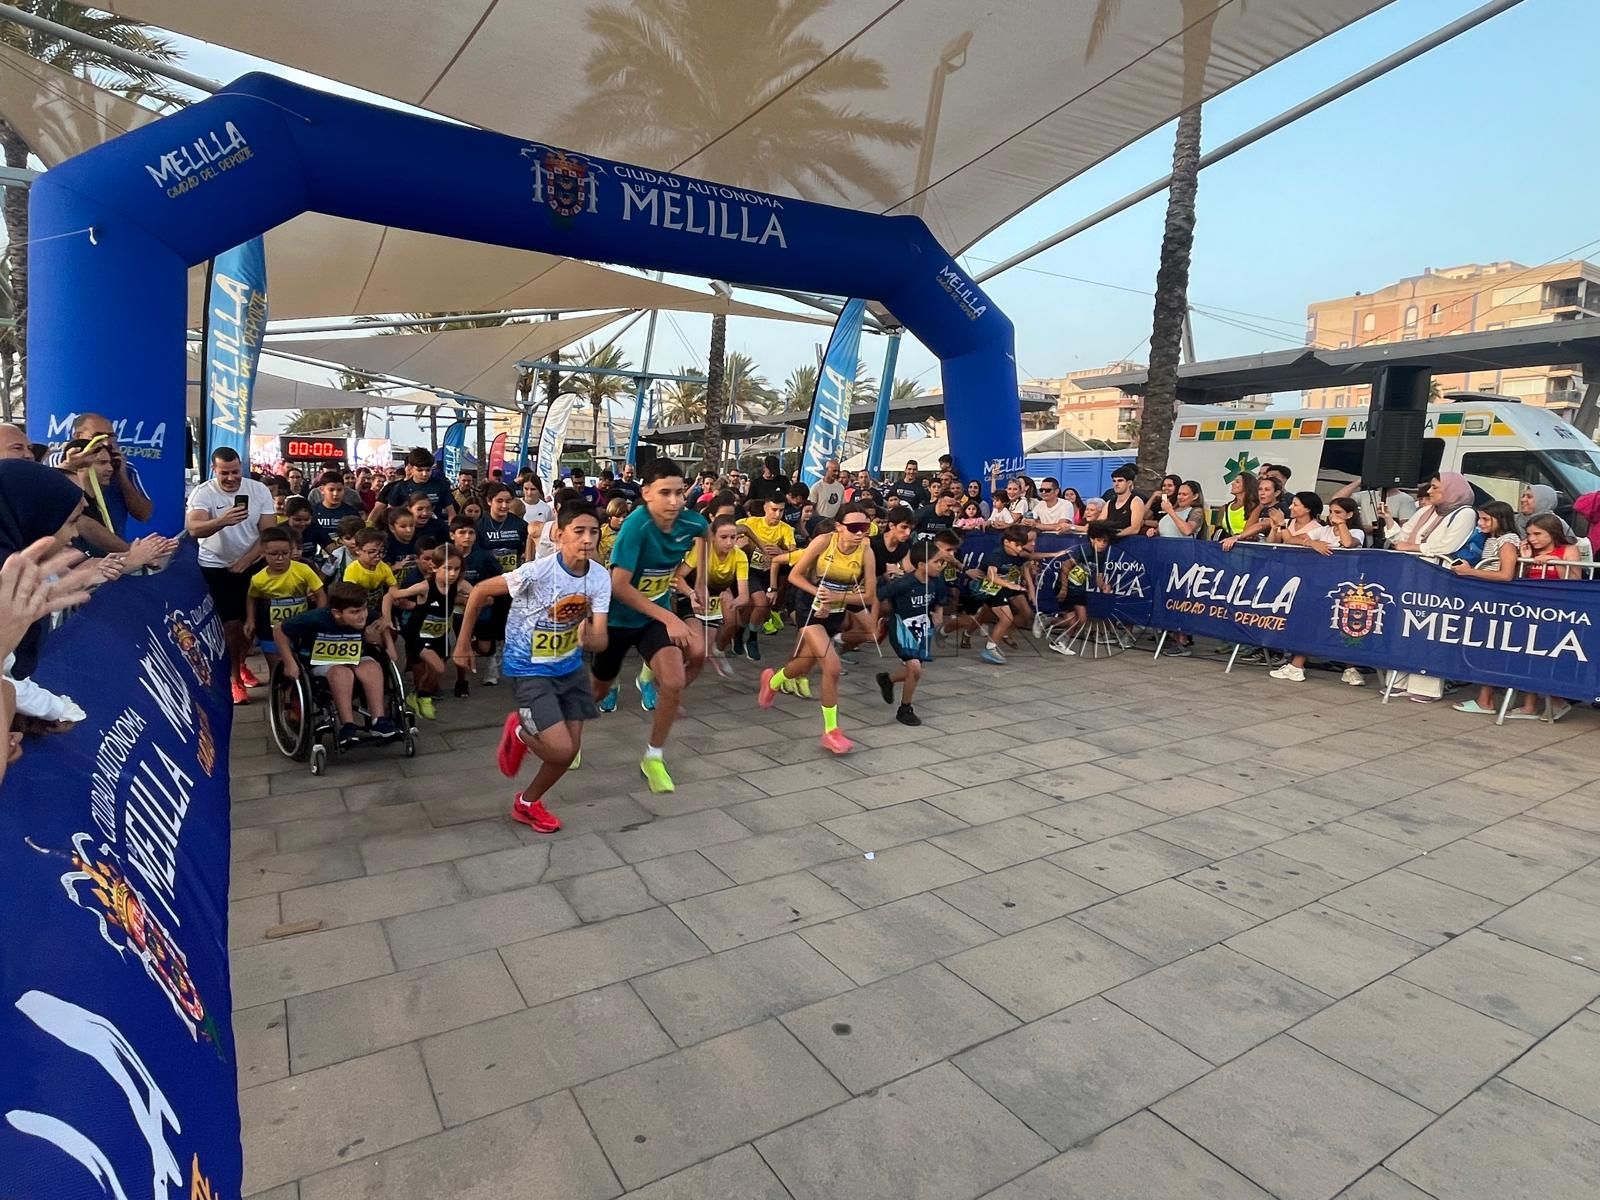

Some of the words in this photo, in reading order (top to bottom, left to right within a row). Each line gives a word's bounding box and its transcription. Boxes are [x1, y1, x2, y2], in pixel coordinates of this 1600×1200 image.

[144, 121, 247, 188] MELILLA
[613, 166, 680, 188] CIUDAD
[687, 181, 784, 210] AUTÓNOMA
[634, 184, 646, 194] DE
[620, 182, 787, 248] MELILLA
[939, 265, 987, 317] MELILLA
[210, 273, 250, 434] MELILLA
[47, 413, 165, 447] MILLA
[806, 366, 846, 478] MELILLA
[1166, 563, 1301, 614] MELILLA
[1402, 591, 1465, 611] CIUDAD
[1470, 600, 1592, 626] AUTÓNOMA
[1415, 609, 1426, 618] DE
[1166, 599, 1206, 615] CIUDAD
[1209, 606, 1229, 620] DEL
[1234, 611, 1288, 631] DEPORTE
[1402, 609, 1588, 662] MELILLA
[315, 642, 359, 657] 2089
[96, 706, 147, 790] AUTÓNOMA
[125, 741, 194, 928] MELILLA
